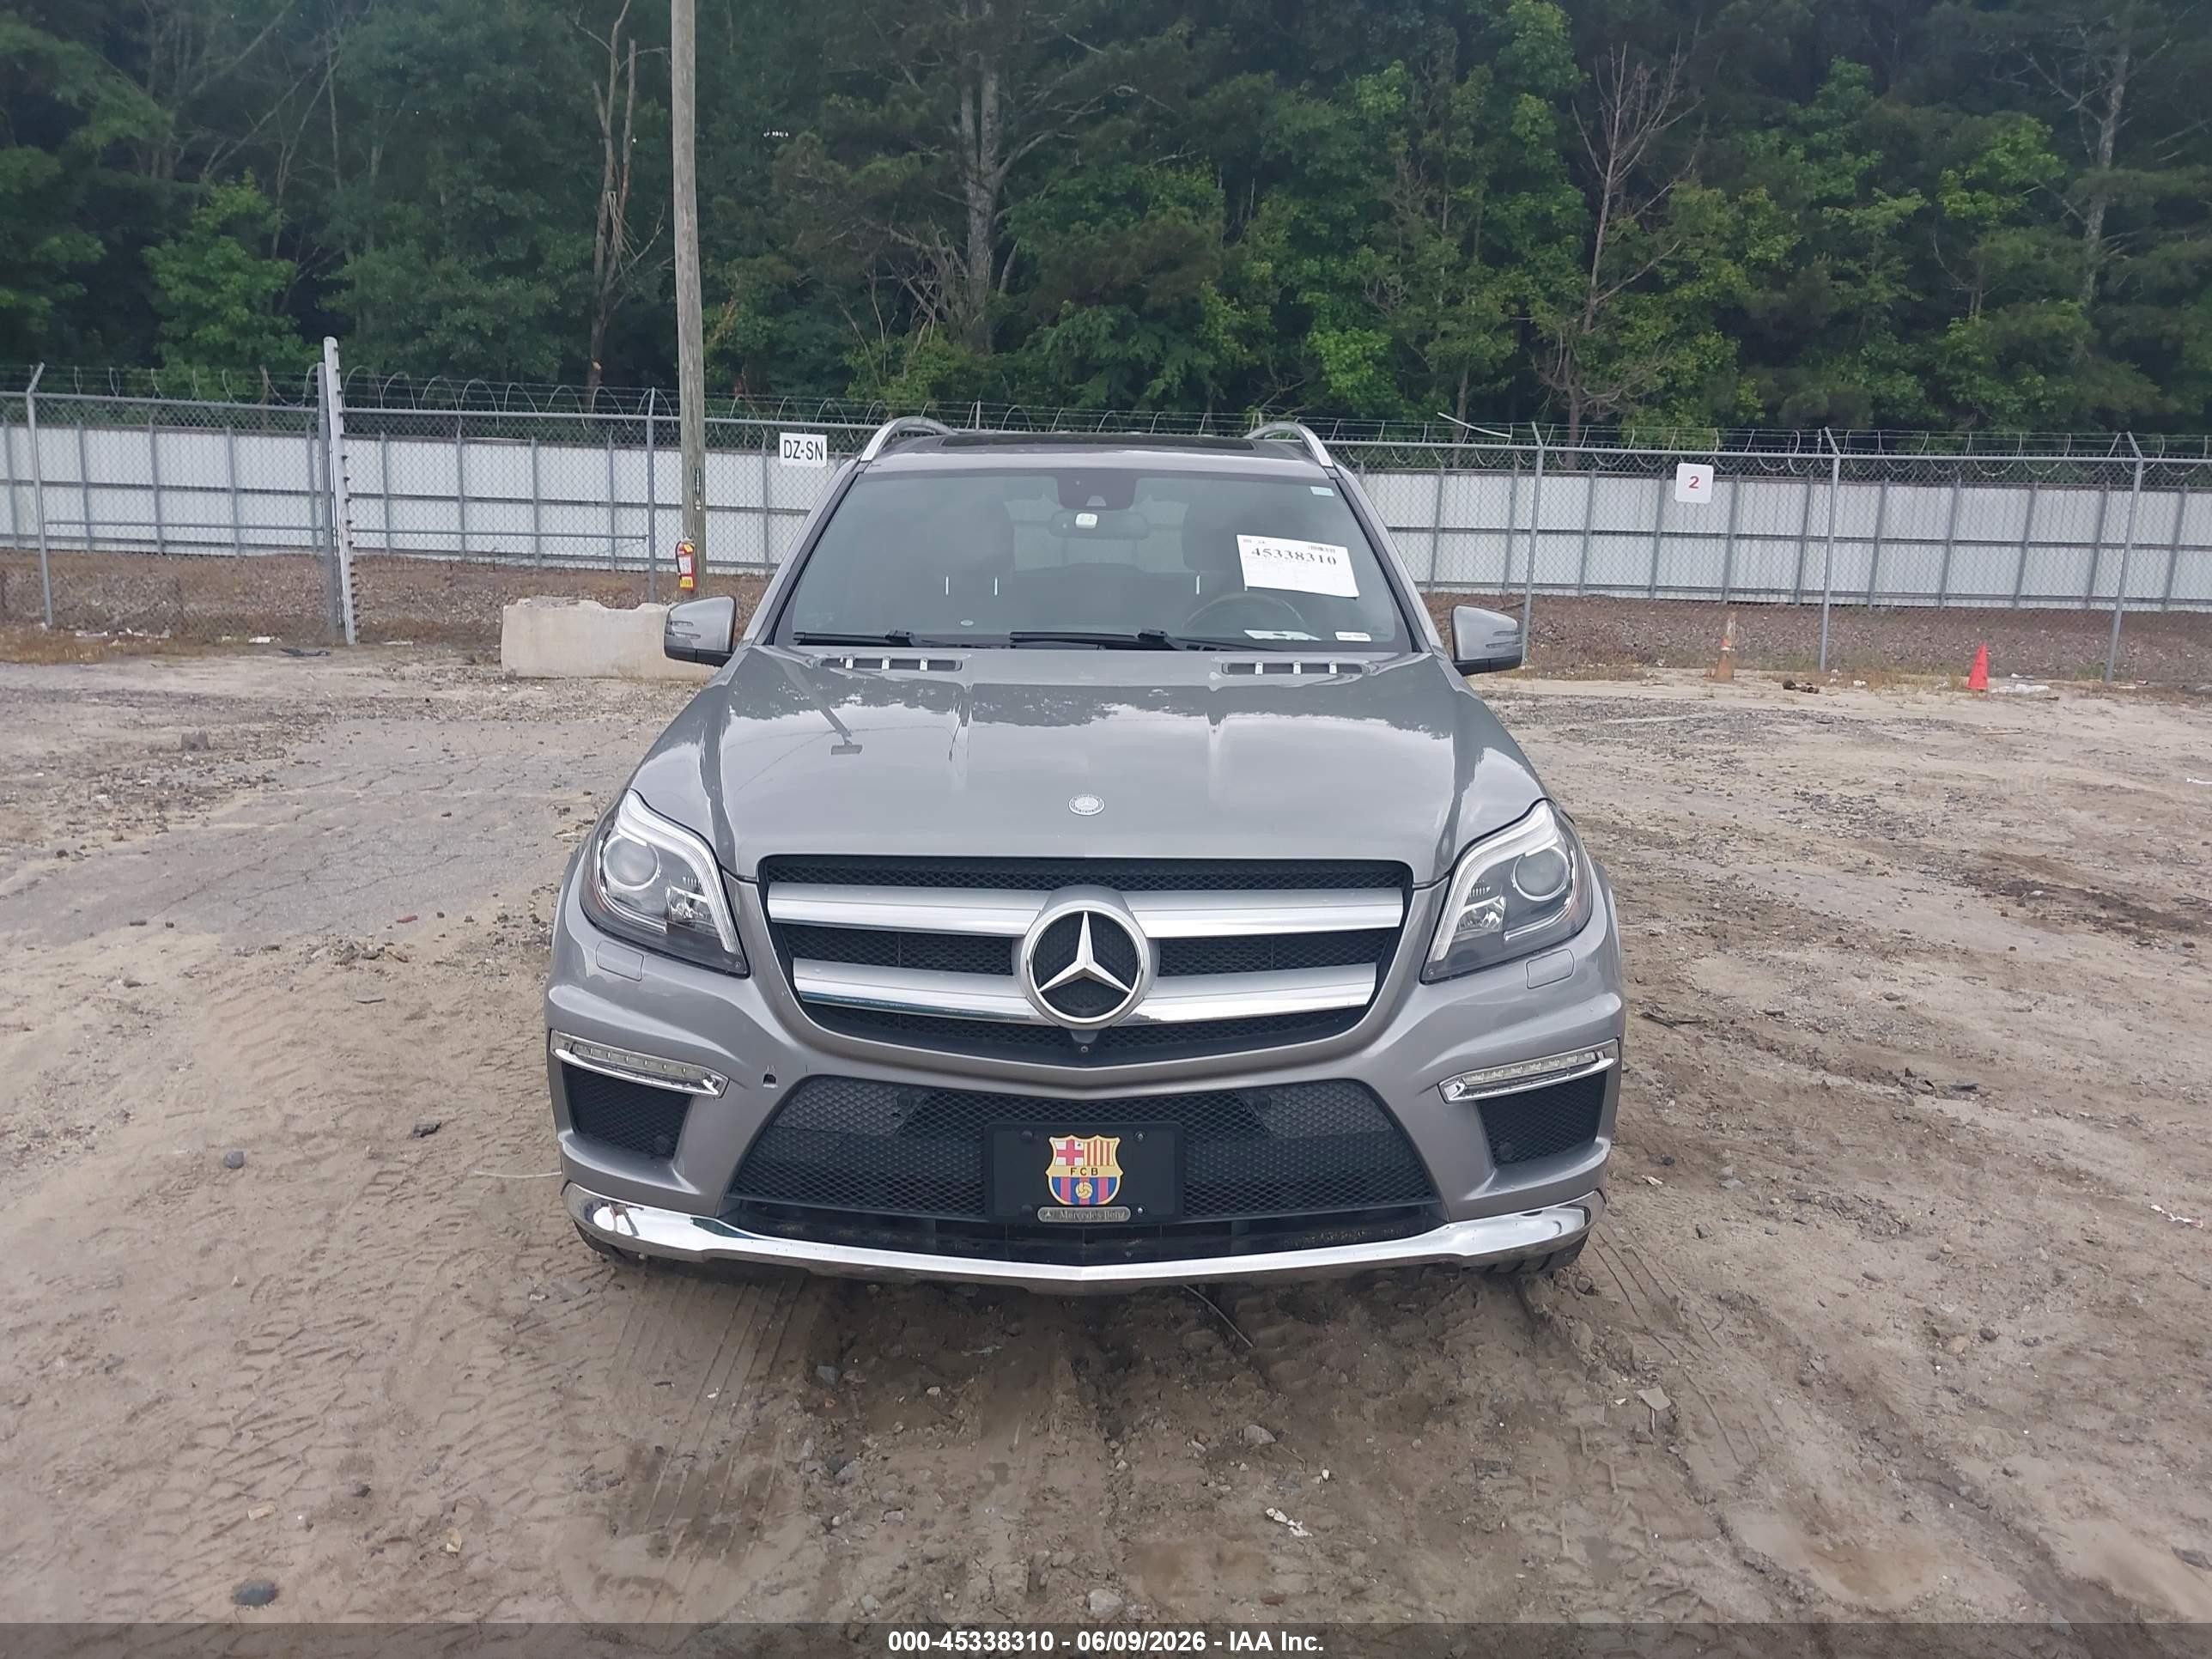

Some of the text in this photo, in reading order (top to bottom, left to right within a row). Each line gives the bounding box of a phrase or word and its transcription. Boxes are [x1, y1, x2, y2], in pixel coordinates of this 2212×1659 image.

[783, 439, 823, 461] DZ-SN
[1688, 475, 1700, 489] 2
[1251, 547, 1337, 566] 45338310
